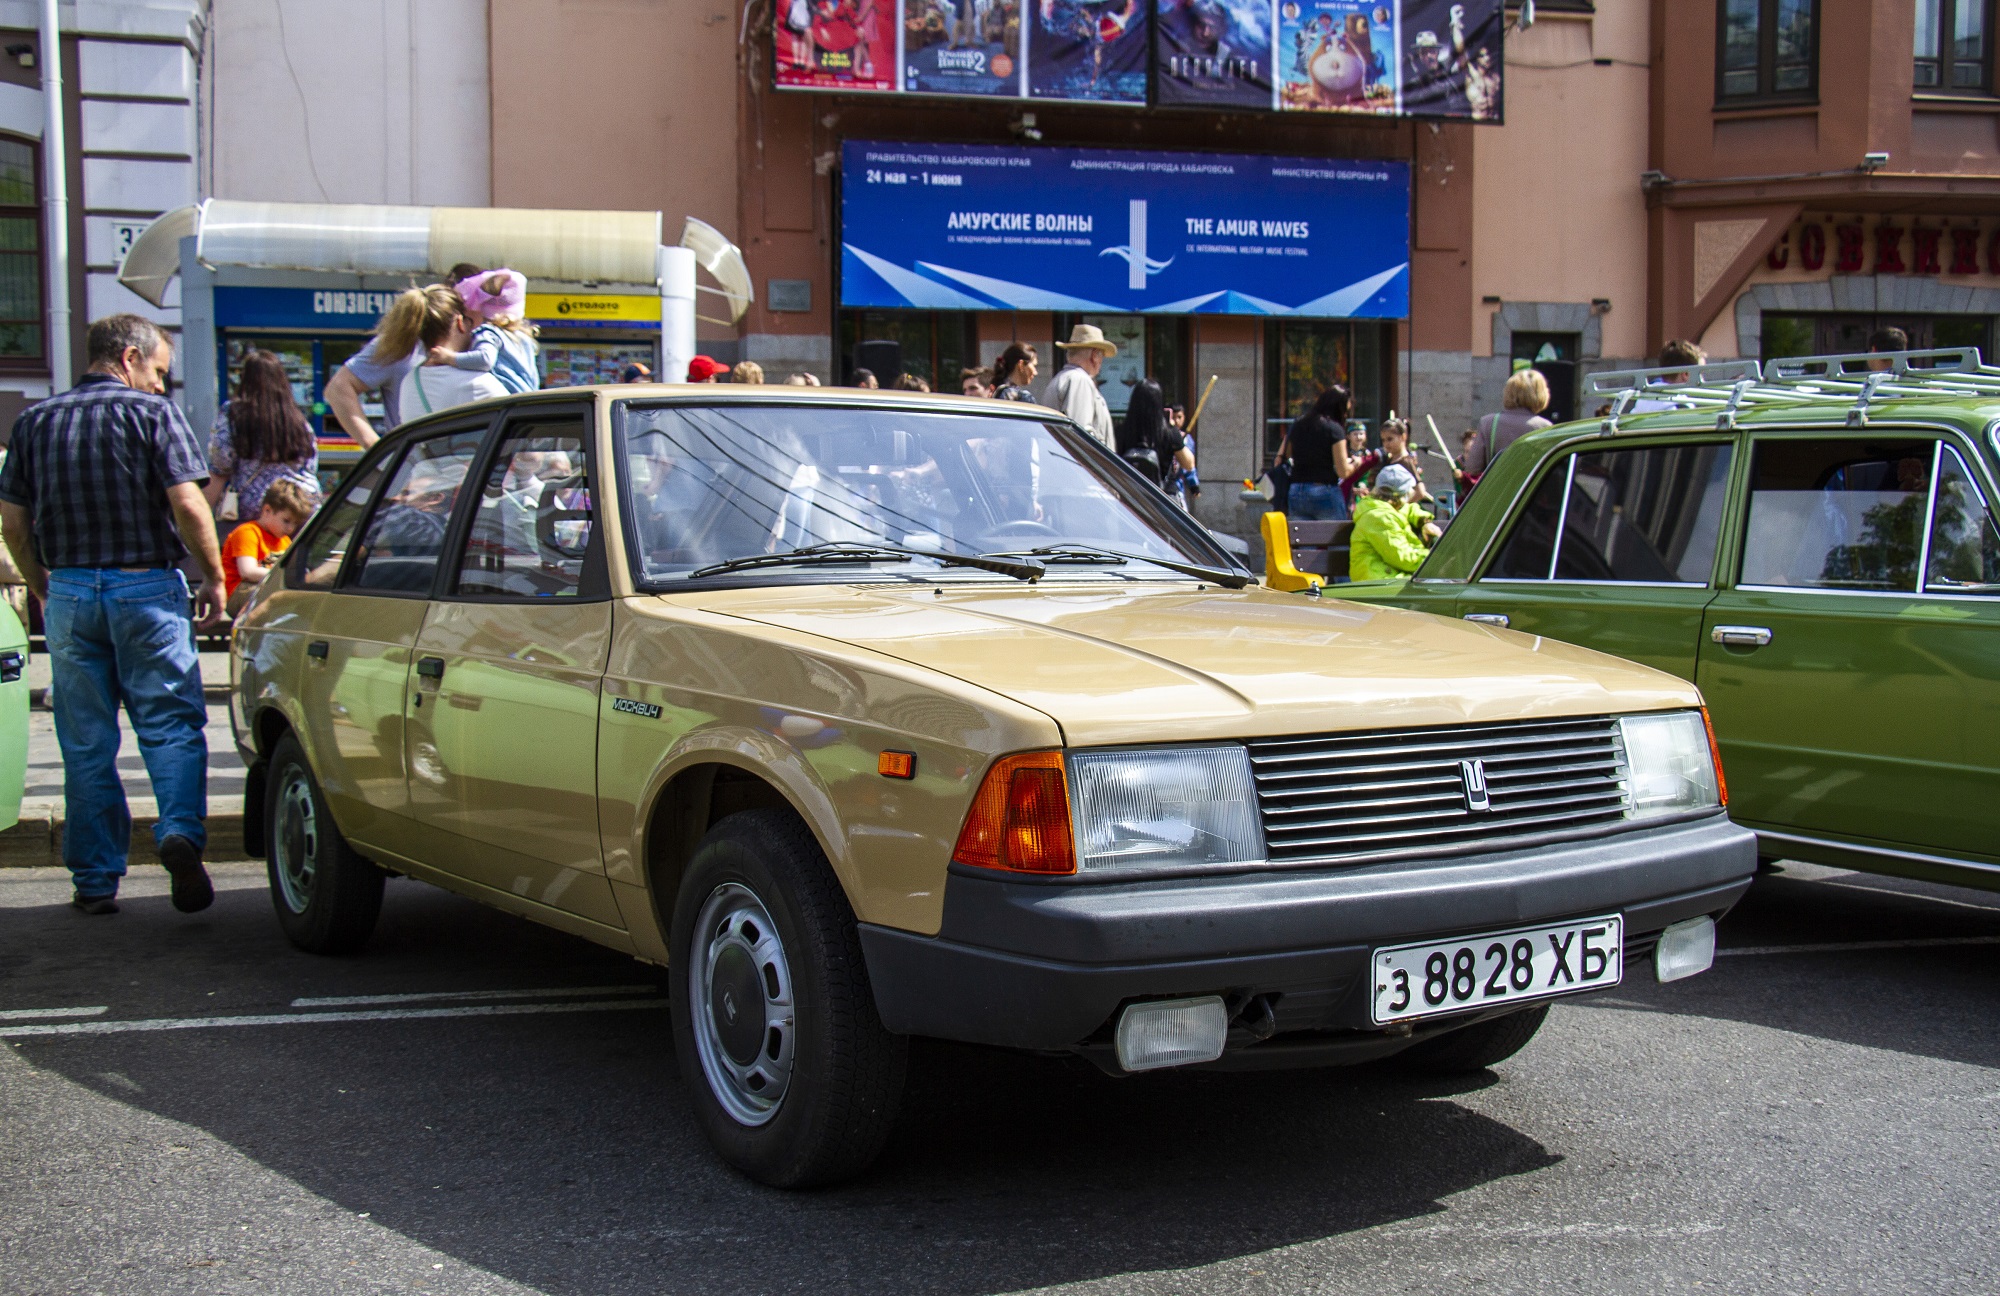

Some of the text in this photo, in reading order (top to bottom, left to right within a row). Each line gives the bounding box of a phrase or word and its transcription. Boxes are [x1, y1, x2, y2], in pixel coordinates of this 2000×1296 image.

[974, 51, 986, 74] 2
[866, 152, 1032, 168] ПРАВИТЕЛЬСТВО ХАБАРОВСКОГО КРАЯ
[1070, 160, 1235, 175] АДМИНИСТРАЦИЯ ГОРОДА ХАБАРОВСКА
[866, 170, 882, 184] 24
[885, 173, 908, 185] мая
[922, 171, 929, 186] 1
[932, 175, 963, 187] июня
[1271, 168, 1335, 180] МИНИСТЕРСТВО
[1336, 171, 1375, 181] ОБОРОНЫ
[948, 212, 1093, 233] АМУРСКИЕ ВОЛНЫ
[1187, 218, 1309, 239] THE AMUR WAVES
[1548, 927, 1608, 986] ХБ
